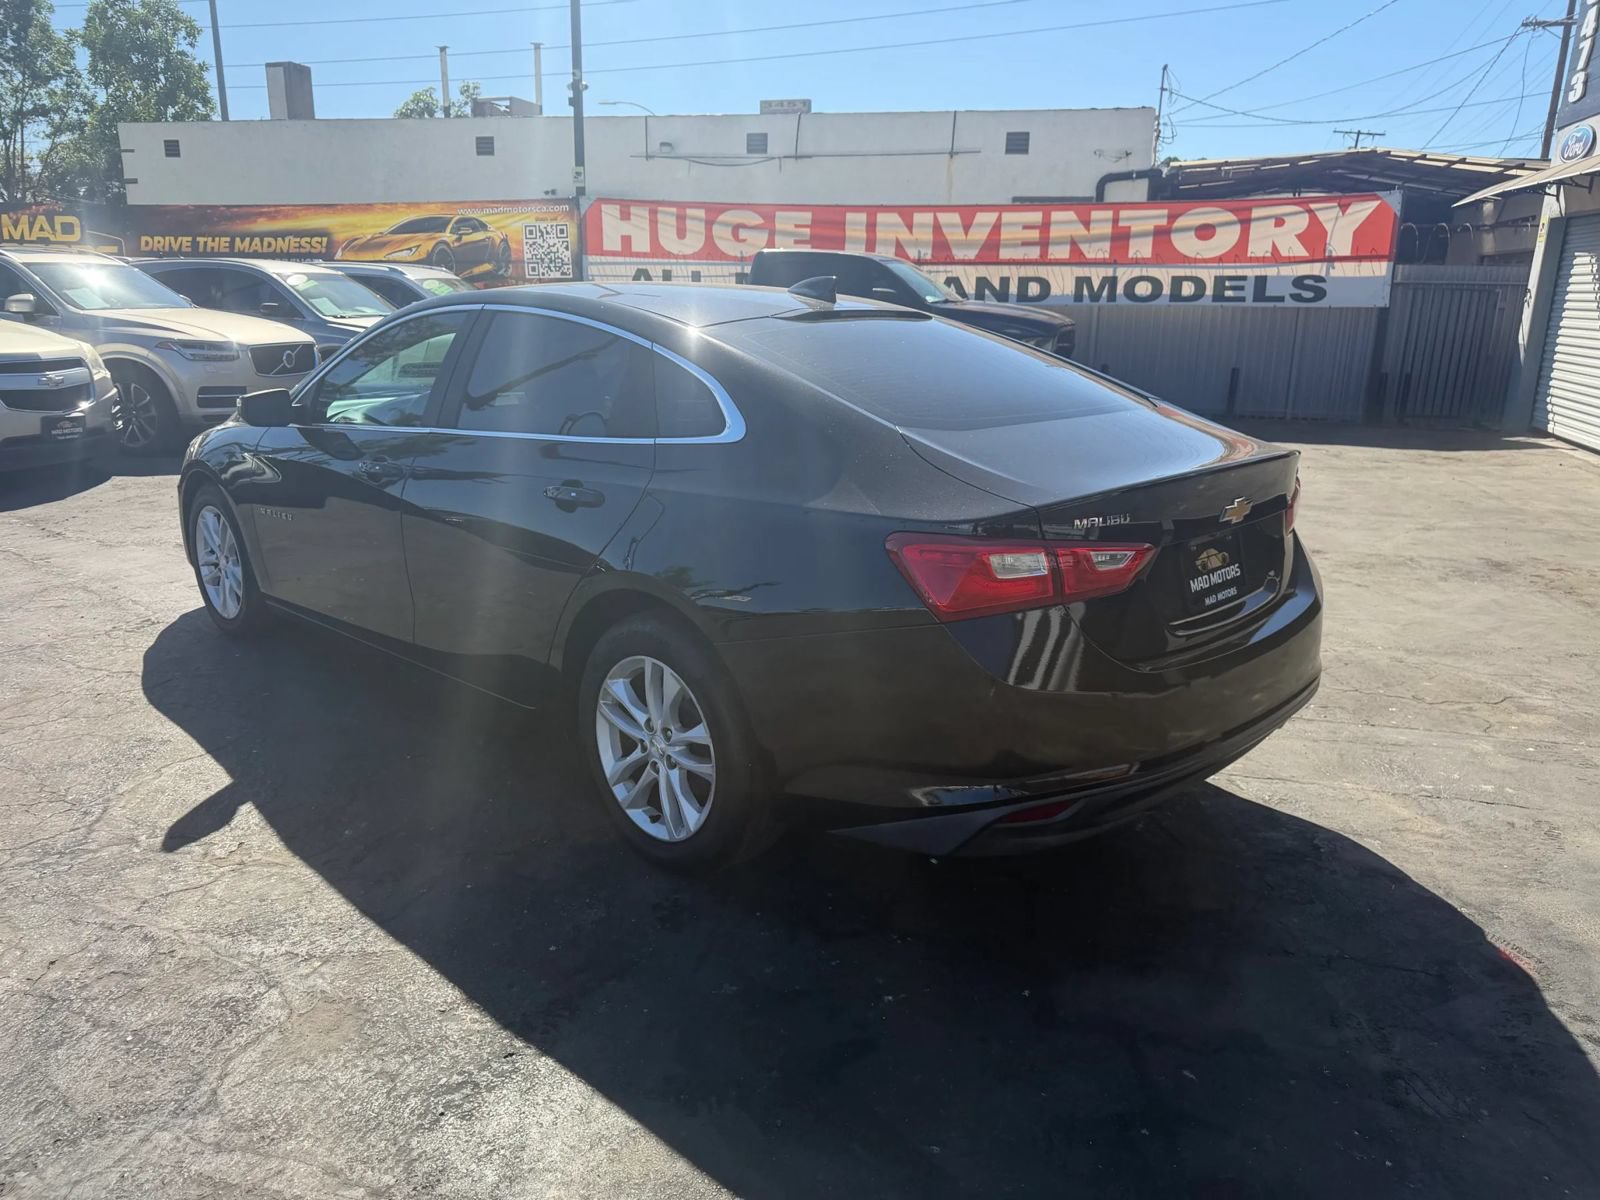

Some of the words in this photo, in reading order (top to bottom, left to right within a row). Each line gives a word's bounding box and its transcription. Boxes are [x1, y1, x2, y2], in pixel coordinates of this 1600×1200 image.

[457, 204, 569, 215] www.madmotorsca.com
[1, 214, 81, 242] MAD
[601, 204, 814, 257] HUGE
[845, 199, 1381, 260] INVENTORY
[140, 236, 193, 252] DRIVE
[196, 237, 231, 252] THE
[234, 237, 328, 253] MADNESS!
[944, 275, 1061, 303] AND
[1073, 274, 1328, 304] MODELS
[1074, 513, 1130, 529] MALIBU
[1189, 575, 1210, 592] MAD
[1209, 563, 1241, 586] MOTORS
[1204, 594, 1217, 606] MAD
[1217, 586, 1238, 600] MOTORS
